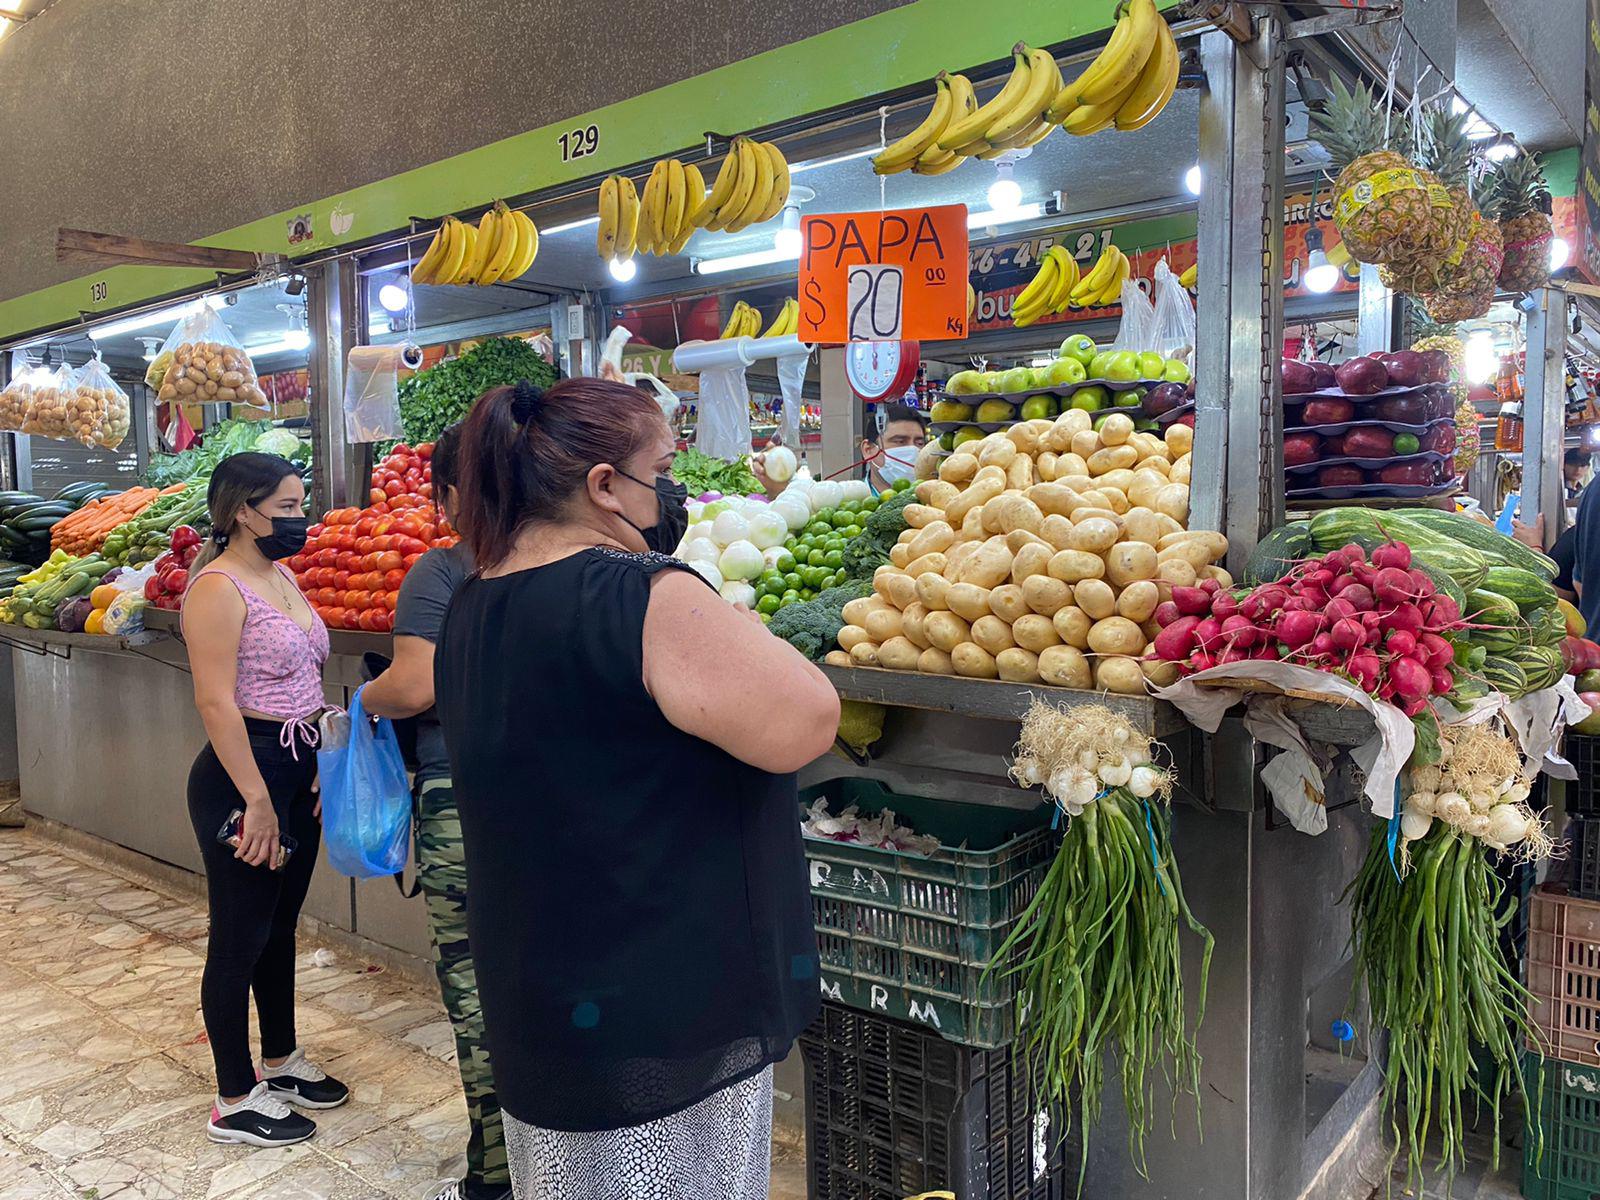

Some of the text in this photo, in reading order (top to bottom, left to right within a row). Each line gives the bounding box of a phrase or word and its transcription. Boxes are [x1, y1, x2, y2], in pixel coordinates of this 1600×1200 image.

[558, 125, 599, 161] 129
[807, 213, 944, 271] PAPA
[90, 281, 107, 302] 130
[804, 267, 946, 341] $ 20 00
[870, 984, 889, 1011] R
[908, 999, 942, 1029] M
